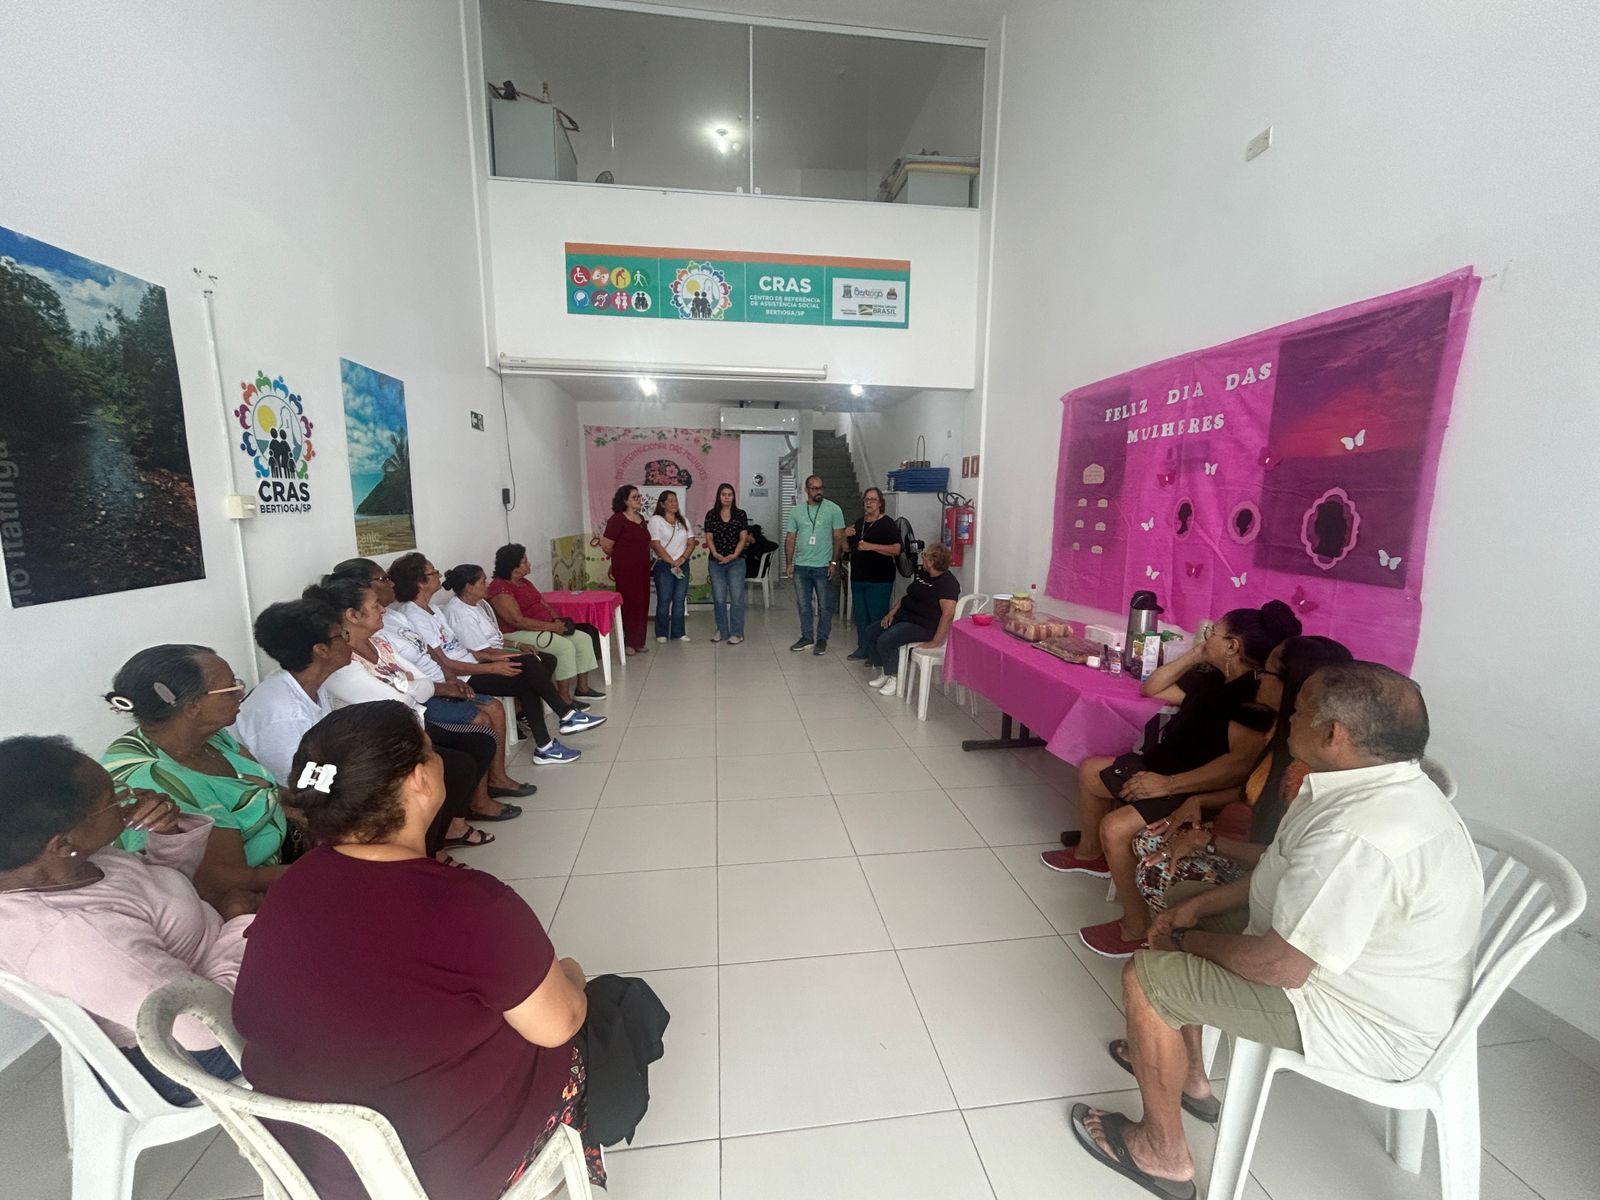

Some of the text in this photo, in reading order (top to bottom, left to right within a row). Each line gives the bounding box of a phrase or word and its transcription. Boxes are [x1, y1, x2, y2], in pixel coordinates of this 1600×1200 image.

[759, 275, 812, 293] CRAS
[1104, 362, 1272, 423] FELIZ DIA DAS
[1126, 413, 1225, 444] MULHERES
[258, 480, 310, 502] CRAS
[260, 503, 312, 514] BERTIOGA/SP
